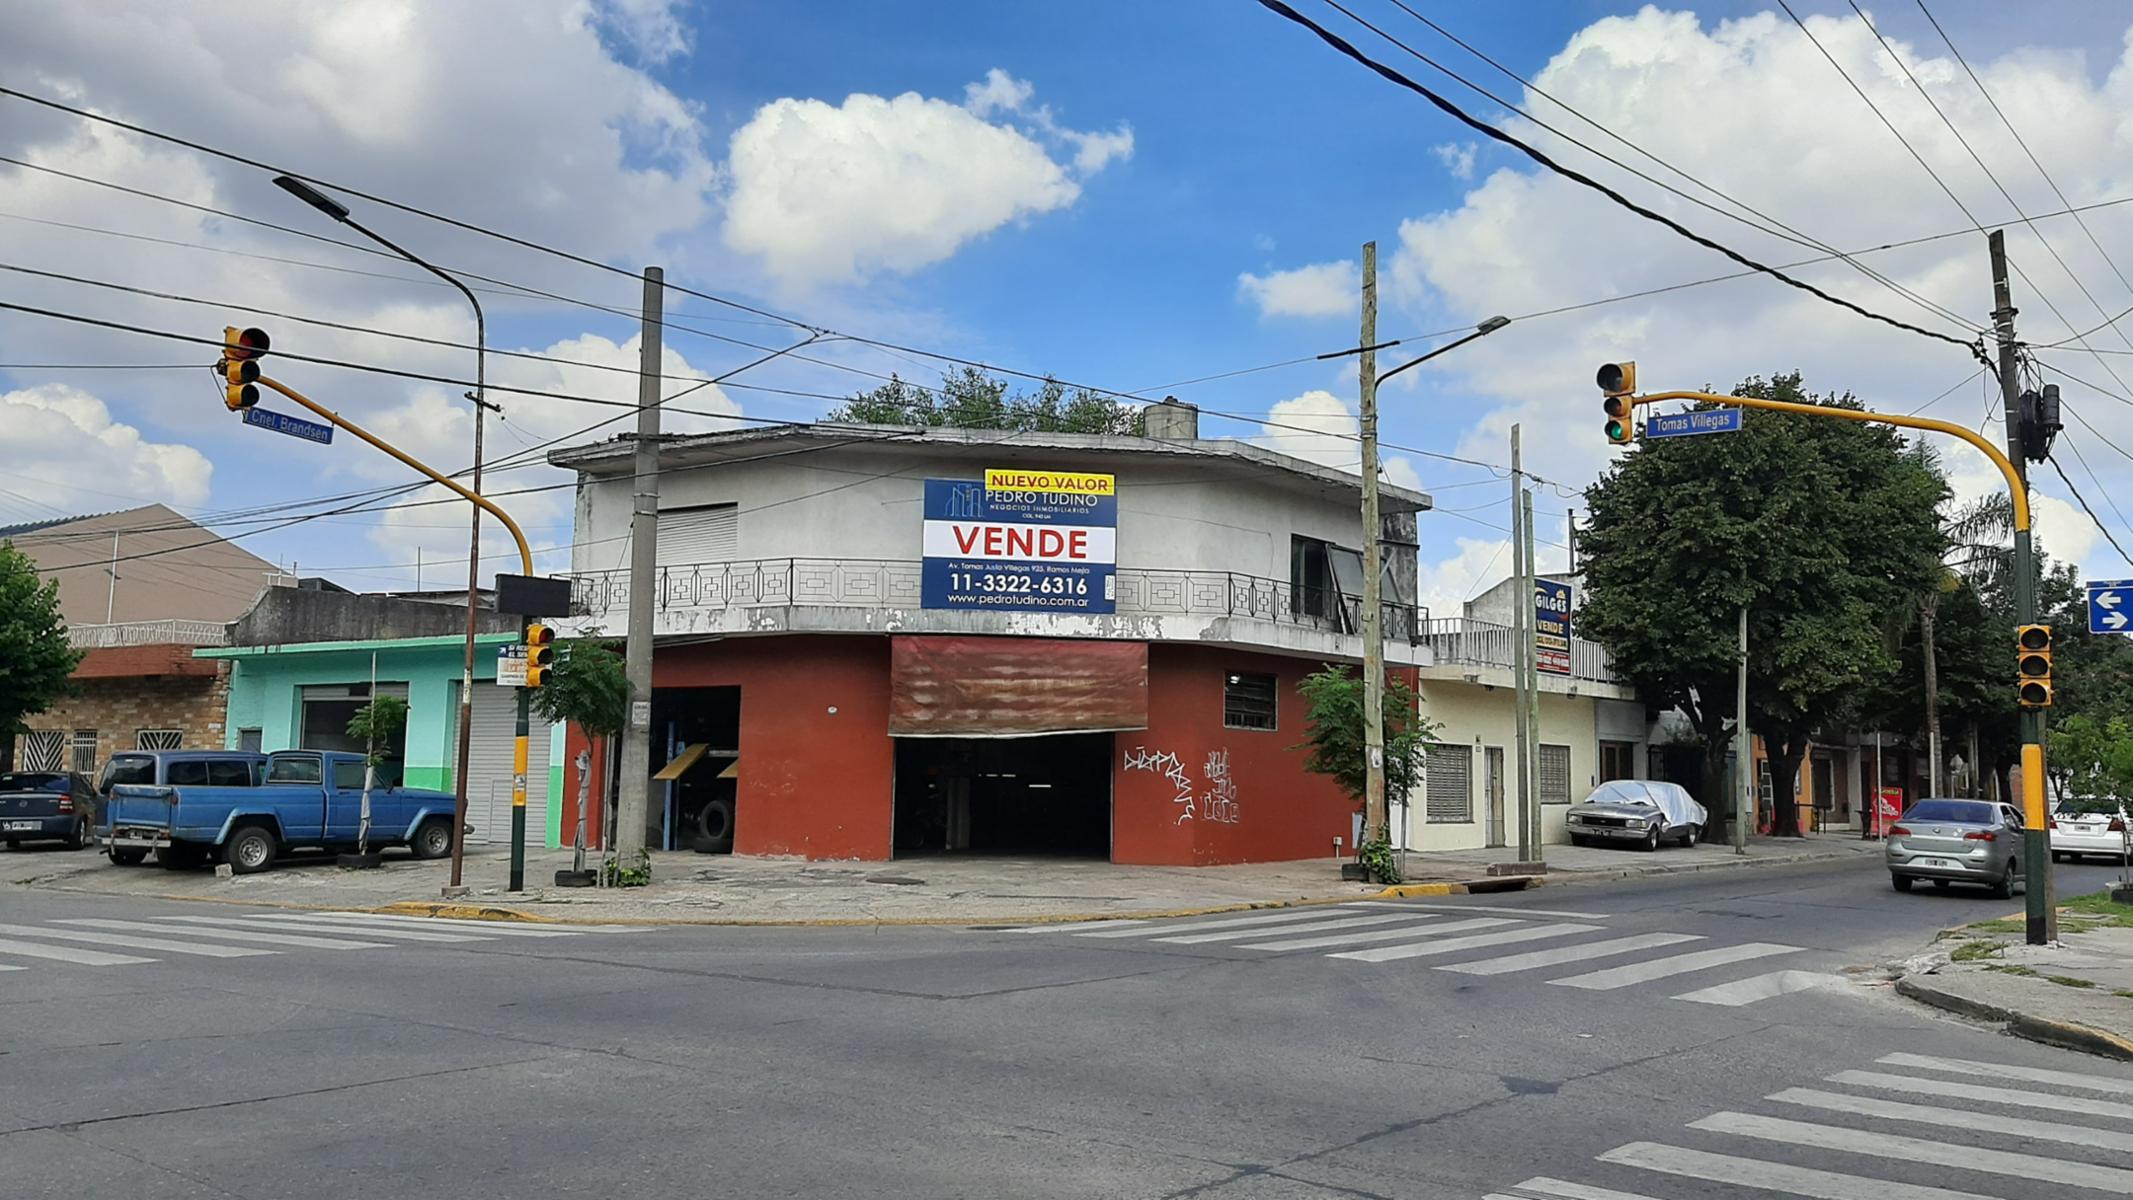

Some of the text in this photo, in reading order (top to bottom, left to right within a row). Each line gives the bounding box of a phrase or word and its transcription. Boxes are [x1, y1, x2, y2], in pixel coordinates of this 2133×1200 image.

[280, 416, 329, 441] Brandsen
[1656, 414, 1730, 431] Tomas Villegas
[992, 474, 1108, 491] NUEVO VALOR
[985, 490, 1098, 507] PEDRO TUDINO
[990, 504, 1090, 514] NEGOCIOS INMOBILIARIOS
[952, 525, 1087, 559] VENDE
[1003, 564, 1030, 574] Villegas
[951, 573, 1088, 595] 11-3322-6316
[948, 594, 1089, 607] www.pedrotudino.com.ar
[1535, 595, 1567, 613] GILGES
[1537, 619, 1564, 634] VENDE
